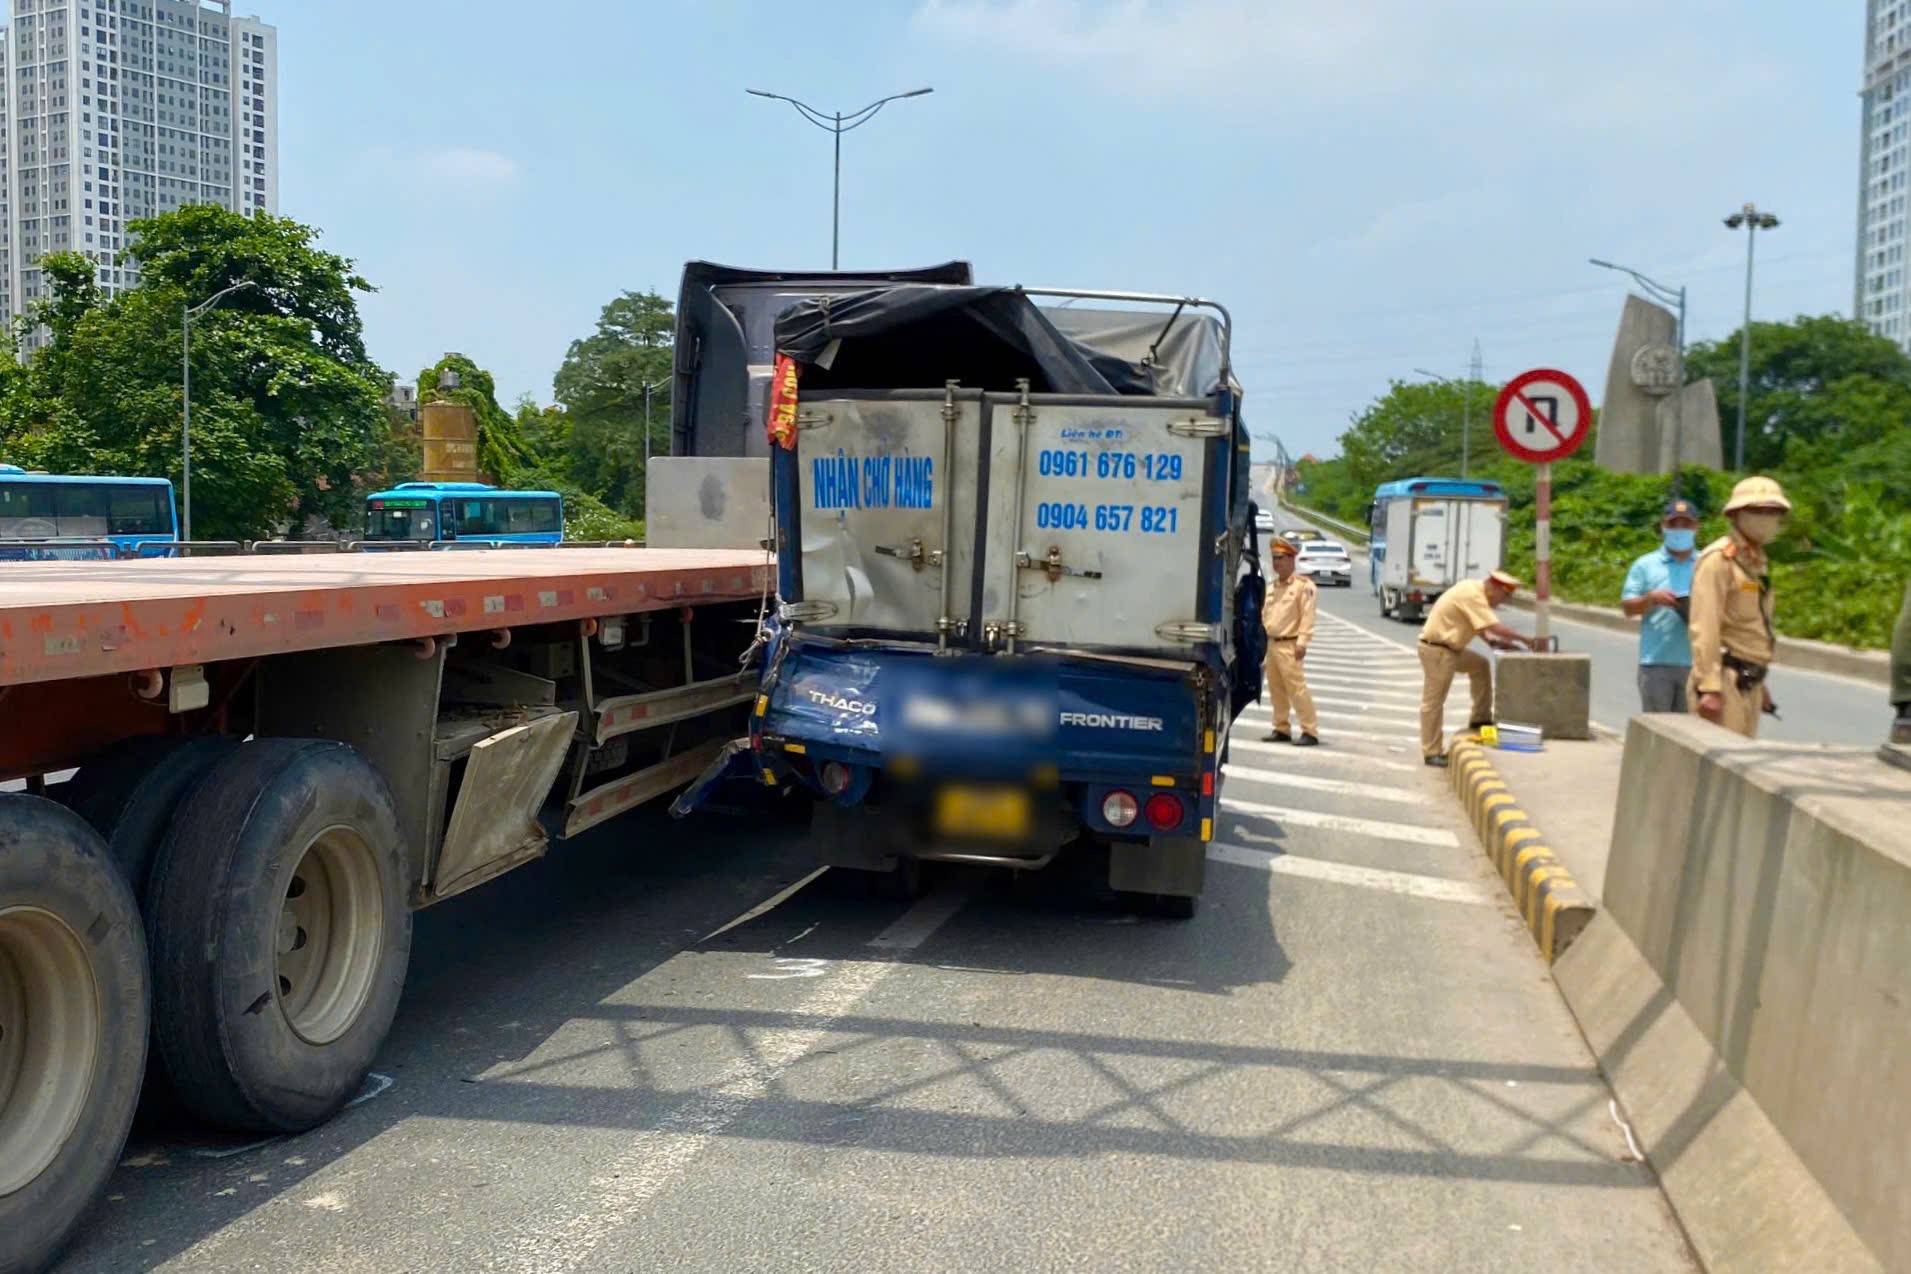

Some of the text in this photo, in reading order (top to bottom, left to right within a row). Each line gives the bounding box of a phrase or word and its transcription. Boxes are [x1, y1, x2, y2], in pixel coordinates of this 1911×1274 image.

[1039, 450, 1183, 480] 0961 676 129
[813, 447, 859, 518] NHẬN
[894, 447, 933, 509] HÀNG
[1037, 503, 1177, 533] 0904 657 821
[809, 690, 876, 715] THACO
[1060, 712, 1163, 731] FRONTIER
